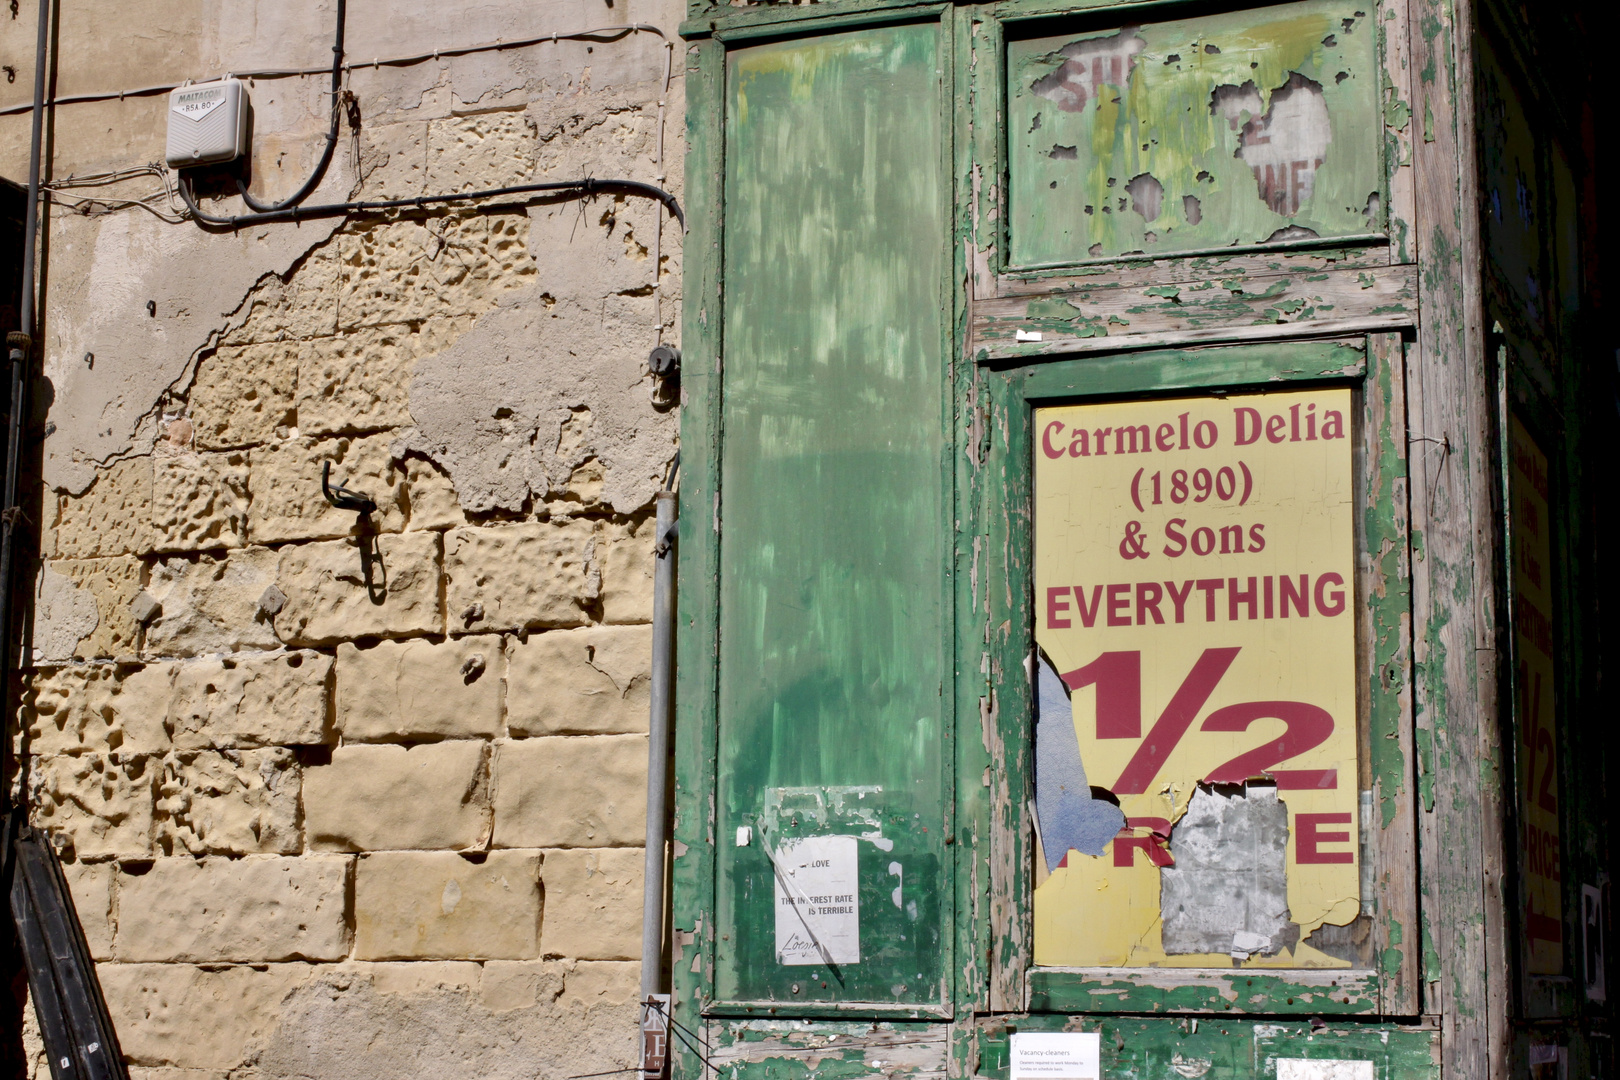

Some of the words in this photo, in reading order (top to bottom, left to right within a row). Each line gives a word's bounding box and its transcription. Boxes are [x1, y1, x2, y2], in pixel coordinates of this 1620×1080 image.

[178, 89, 221, 104] MALTACOM
[1042, 411, 1218, 459] Carmelo
[1233, 402, 1345, 446] Delia
[1130, 460, 1253, 513] (1890)
[1119, 520, 1150, 560] &
[1163, 518, 1266, 557] Sons
[1046, 572, 1346, 629] EVERYTHING
[1060, 647, 1338, 795] 1/2
[1520, 659, 1556, 815] 1/2
[811, 860, 830, 868] LOVE
[781, 897, 795, 905] THE
[797, 895, 832, 904] INEREST
[835, 895, 853, 903] RATE
[818, 906, 853, 914] TERRIBLE
